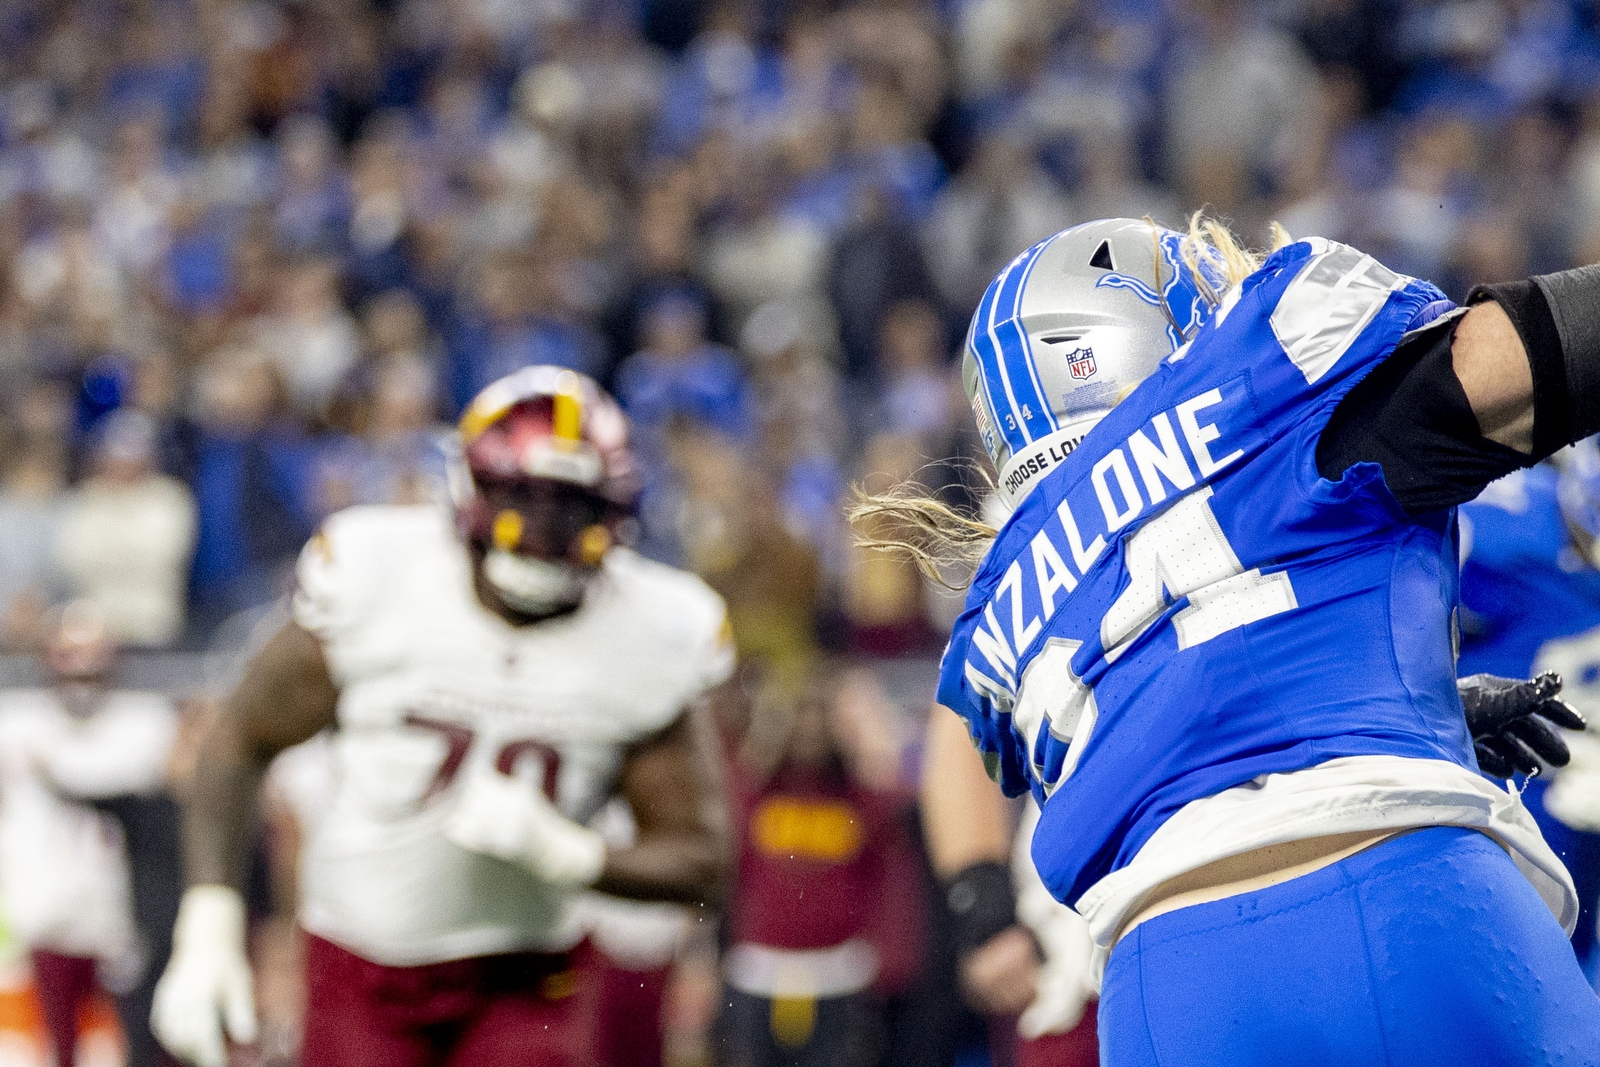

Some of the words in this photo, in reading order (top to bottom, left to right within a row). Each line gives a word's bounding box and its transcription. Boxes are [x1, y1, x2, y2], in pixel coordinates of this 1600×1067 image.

[1071, 359, 1095, 377] NFL
[1004, 452, 1049, 496] CHOOSE
[1049, 434, 1087, 463] LOV
